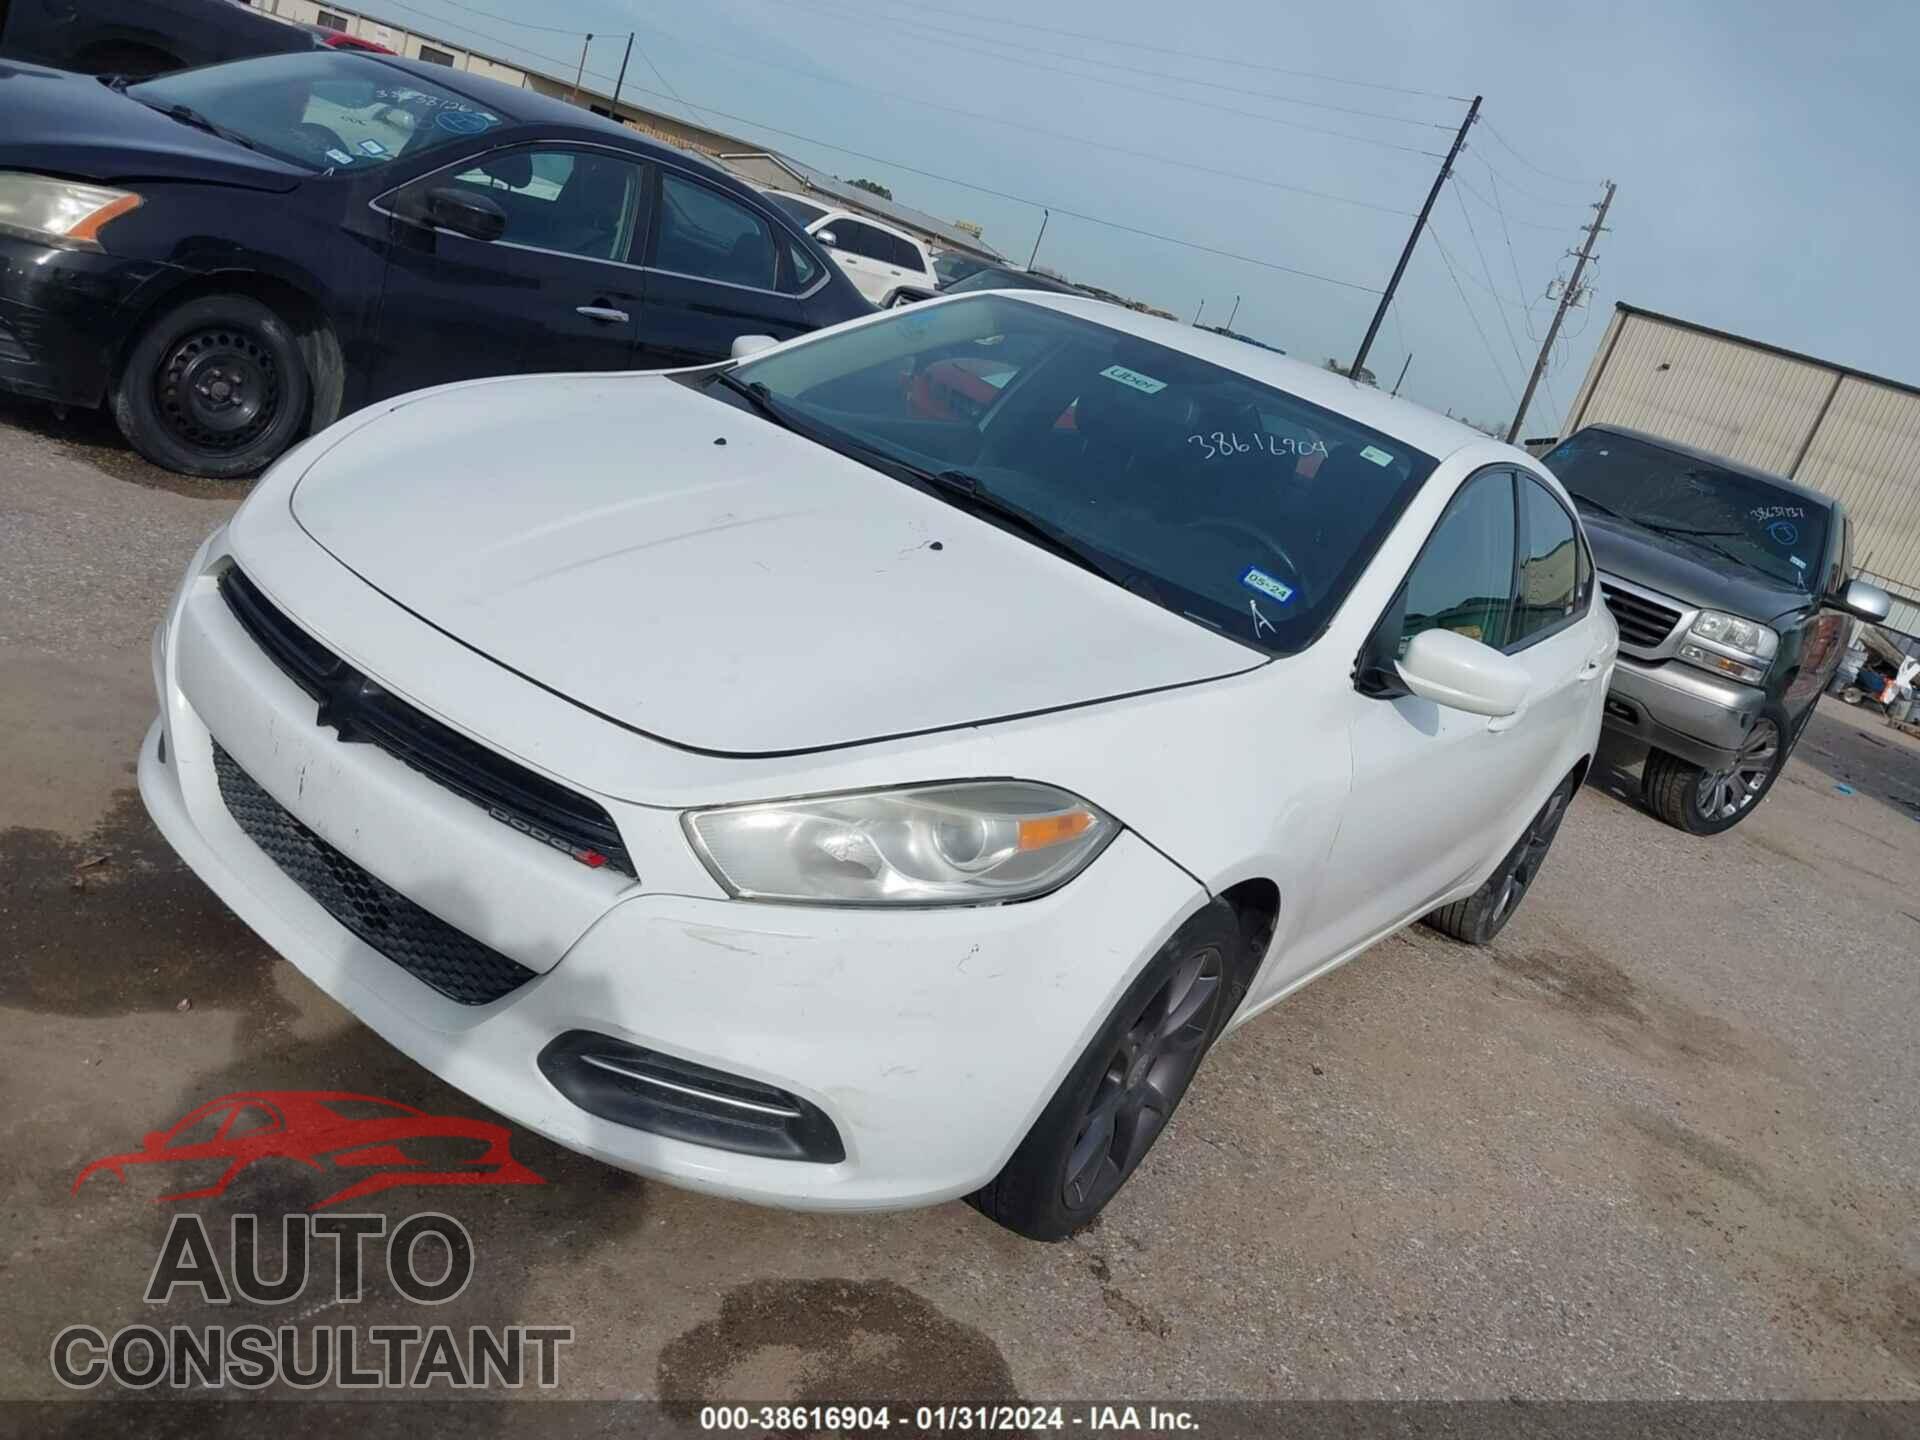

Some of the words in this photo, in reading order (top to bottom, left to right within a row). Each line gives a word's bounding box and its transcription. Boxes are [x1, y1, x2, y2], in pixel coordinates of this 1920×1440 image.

[1187, 431, 1329, 459] 38616904
[1248, 574, 1288, 598] 05-24
[1249, 599, 1276, 639] A
